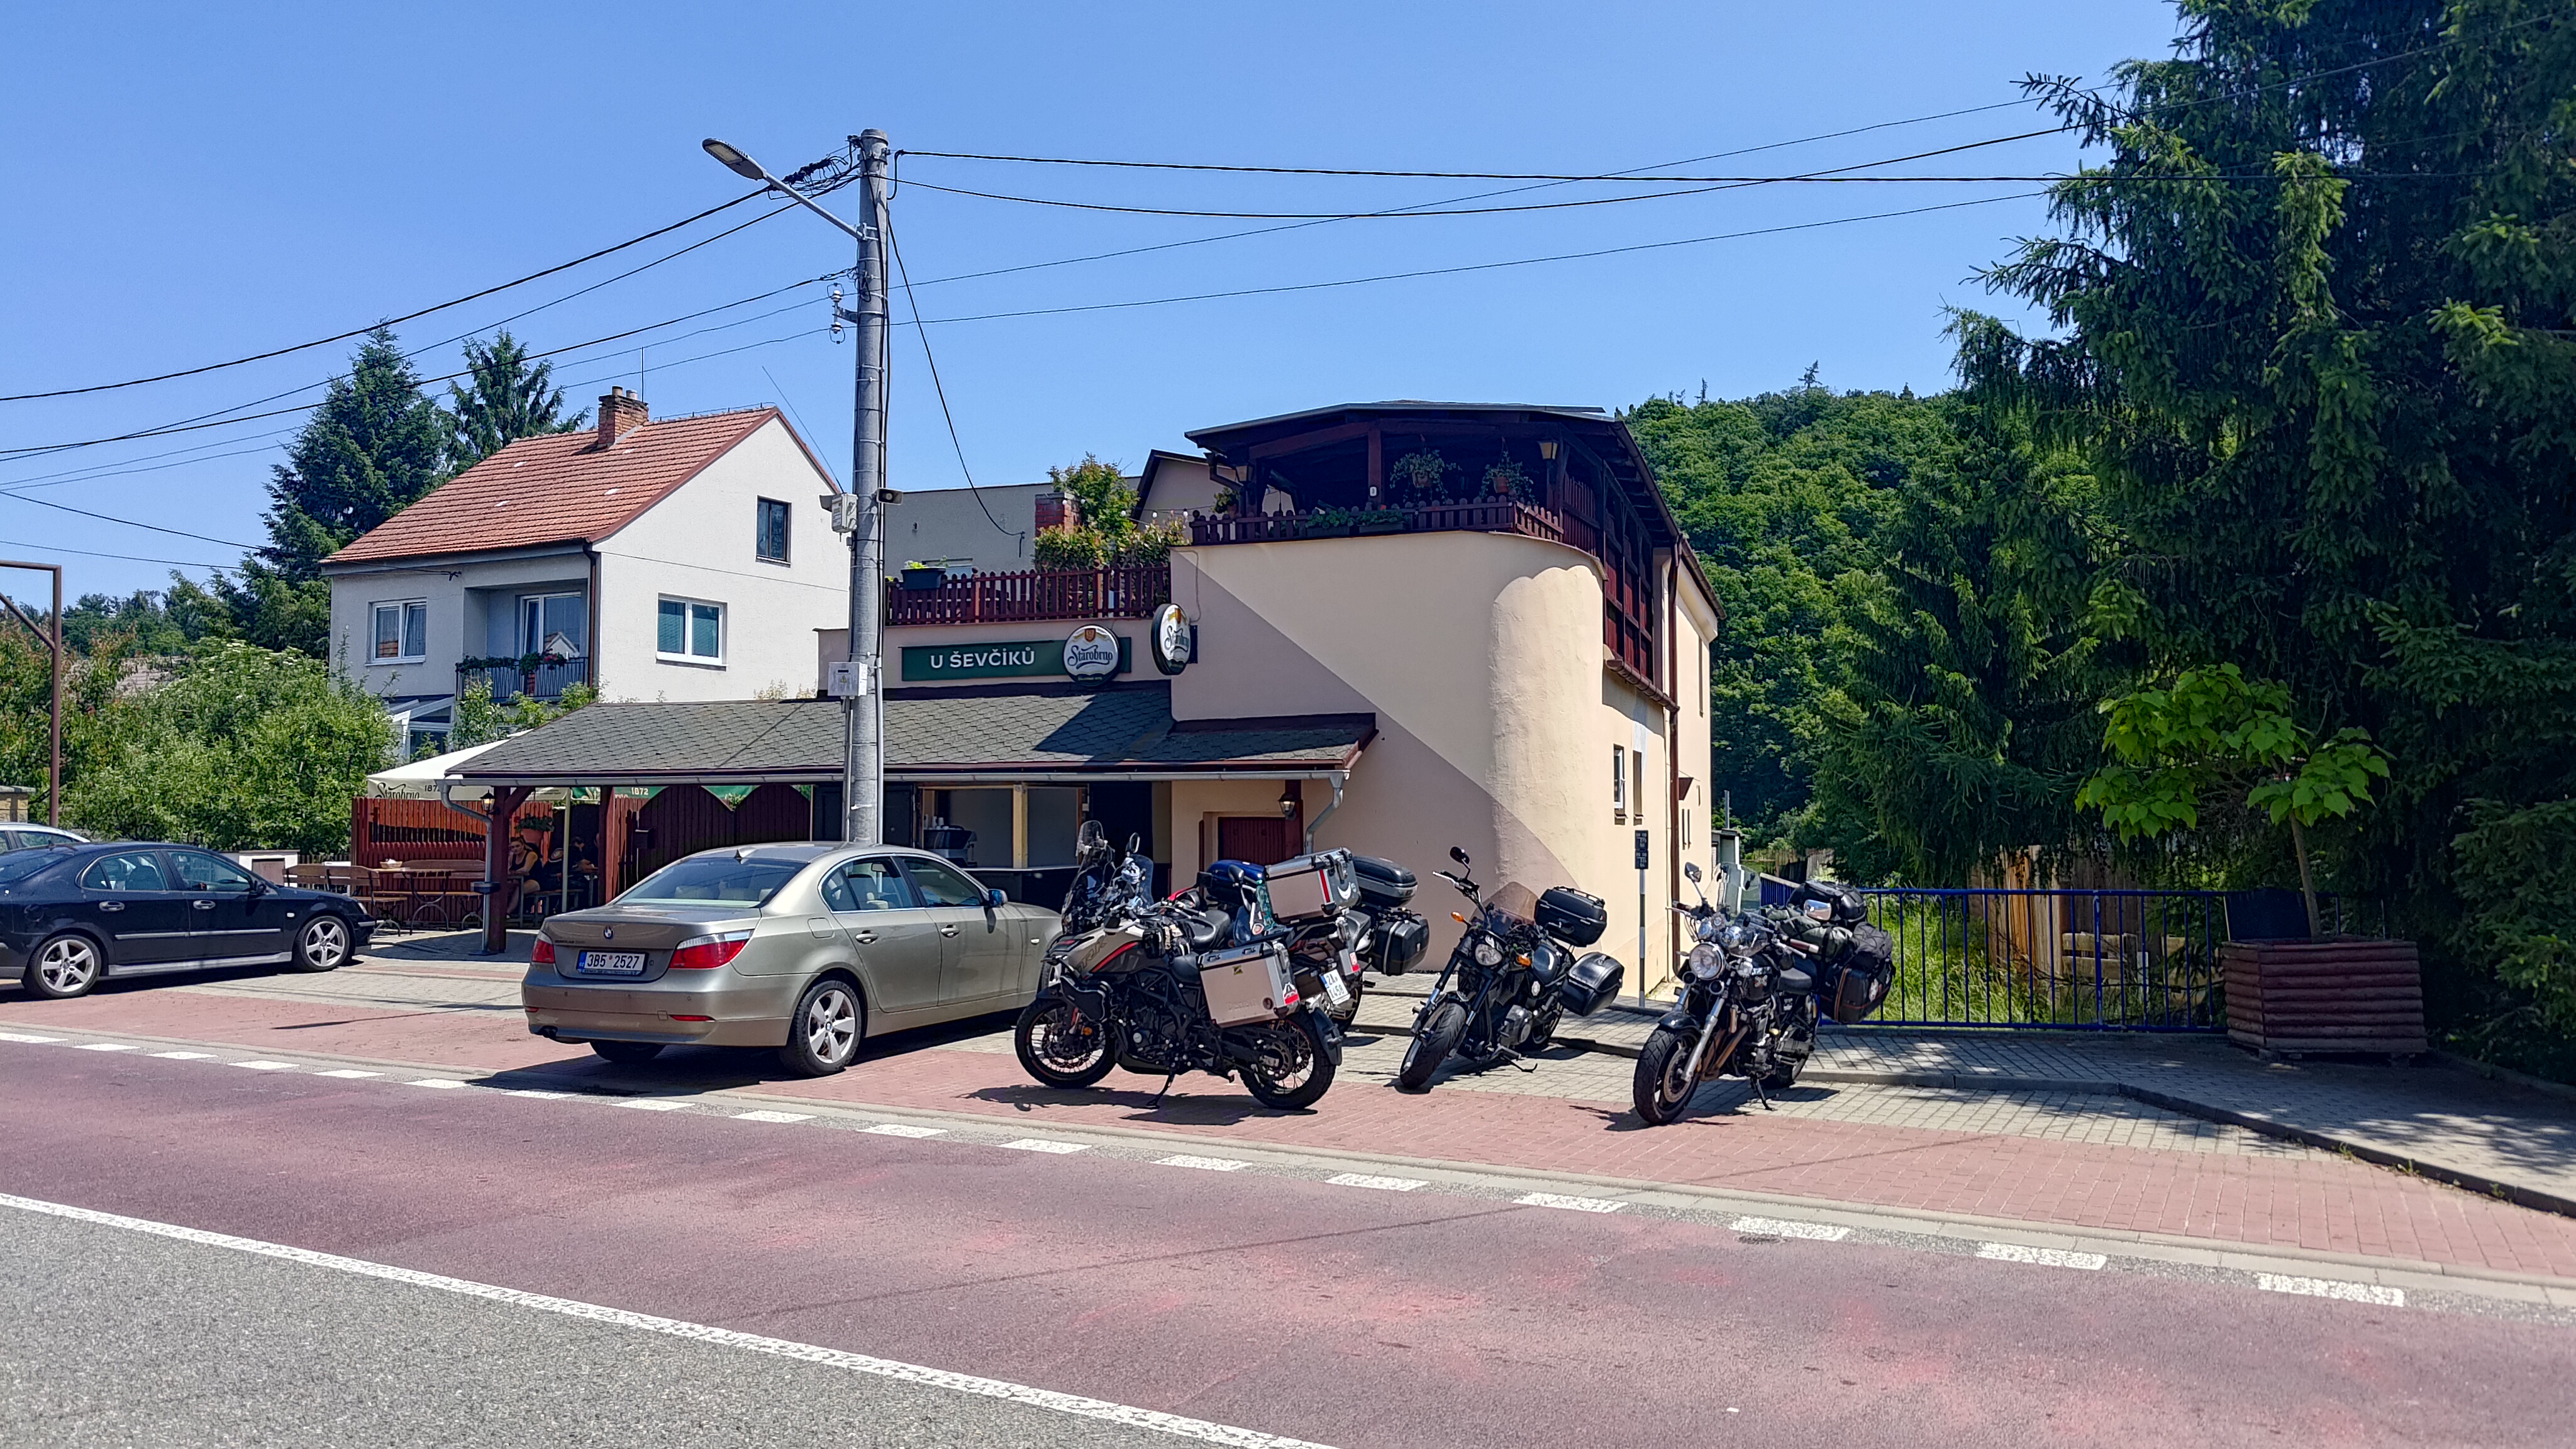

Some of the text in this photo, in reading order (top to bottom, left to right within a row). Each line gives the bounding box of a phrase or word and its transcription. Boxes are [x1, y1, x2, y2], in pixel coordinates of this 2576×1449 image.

[930, 655, 943, 669] U
[1067, 645, 1113, 670] Starobrno
[424, 784, 440, 792] 187
[631, 787, 648, 796] 1872
[587, 953, 640, 969] 3B5 2527
